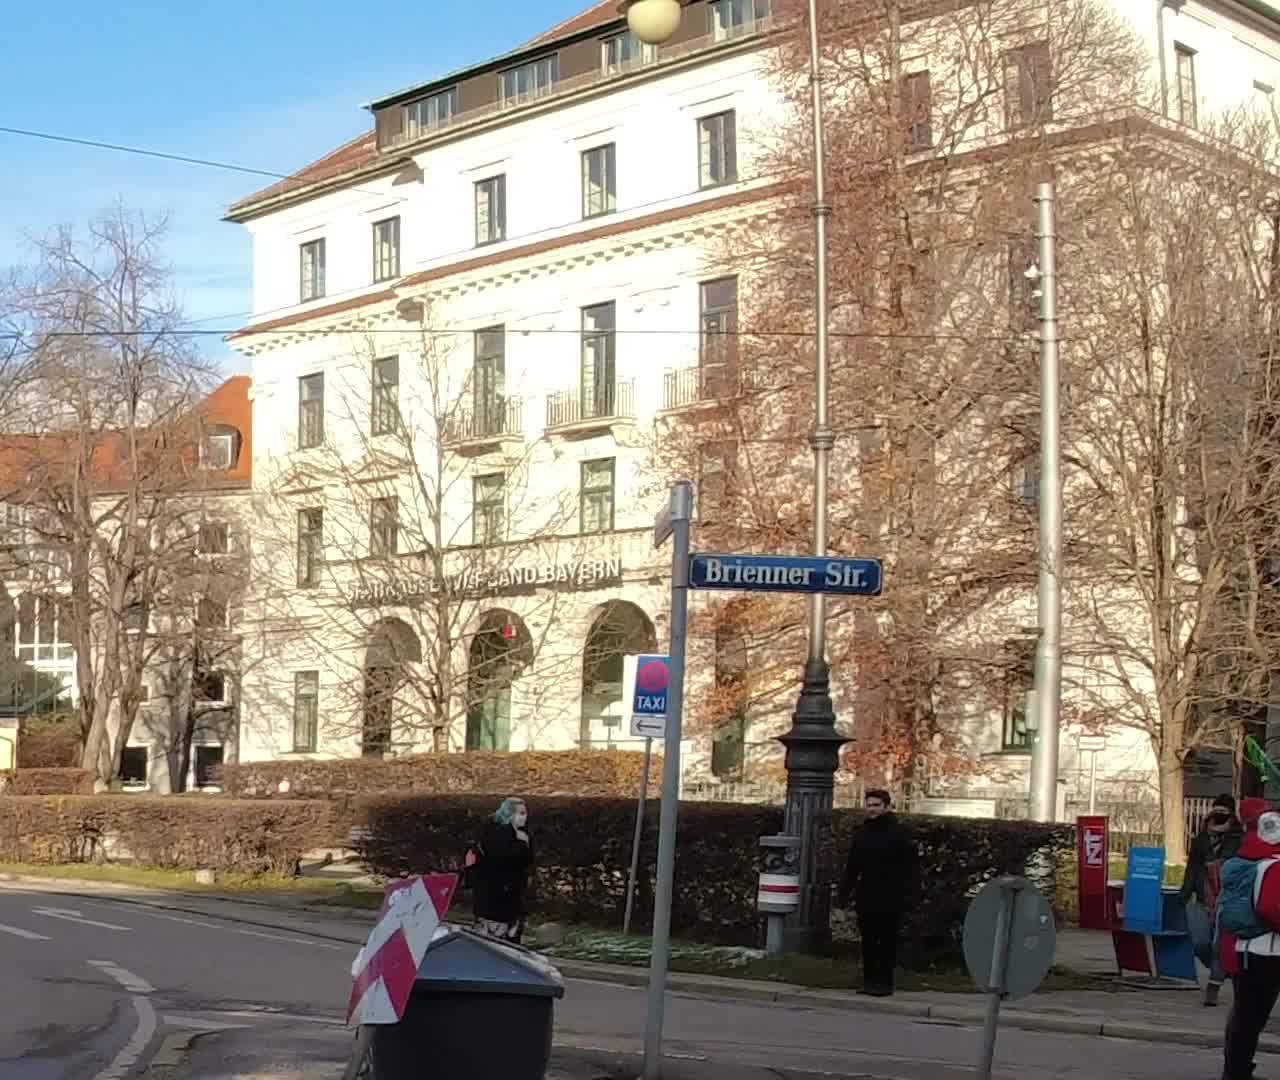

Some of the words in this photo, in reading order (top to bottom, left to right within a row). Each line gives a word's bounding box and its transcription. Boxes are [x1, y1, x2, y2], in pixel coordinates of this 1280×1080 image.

[544, 556, 621, 583] BAYERN
[705, 558, 816, 585] Brienner
[824, 561, 868, 587] Str.
[636, 695, 666, 711] TAXI
